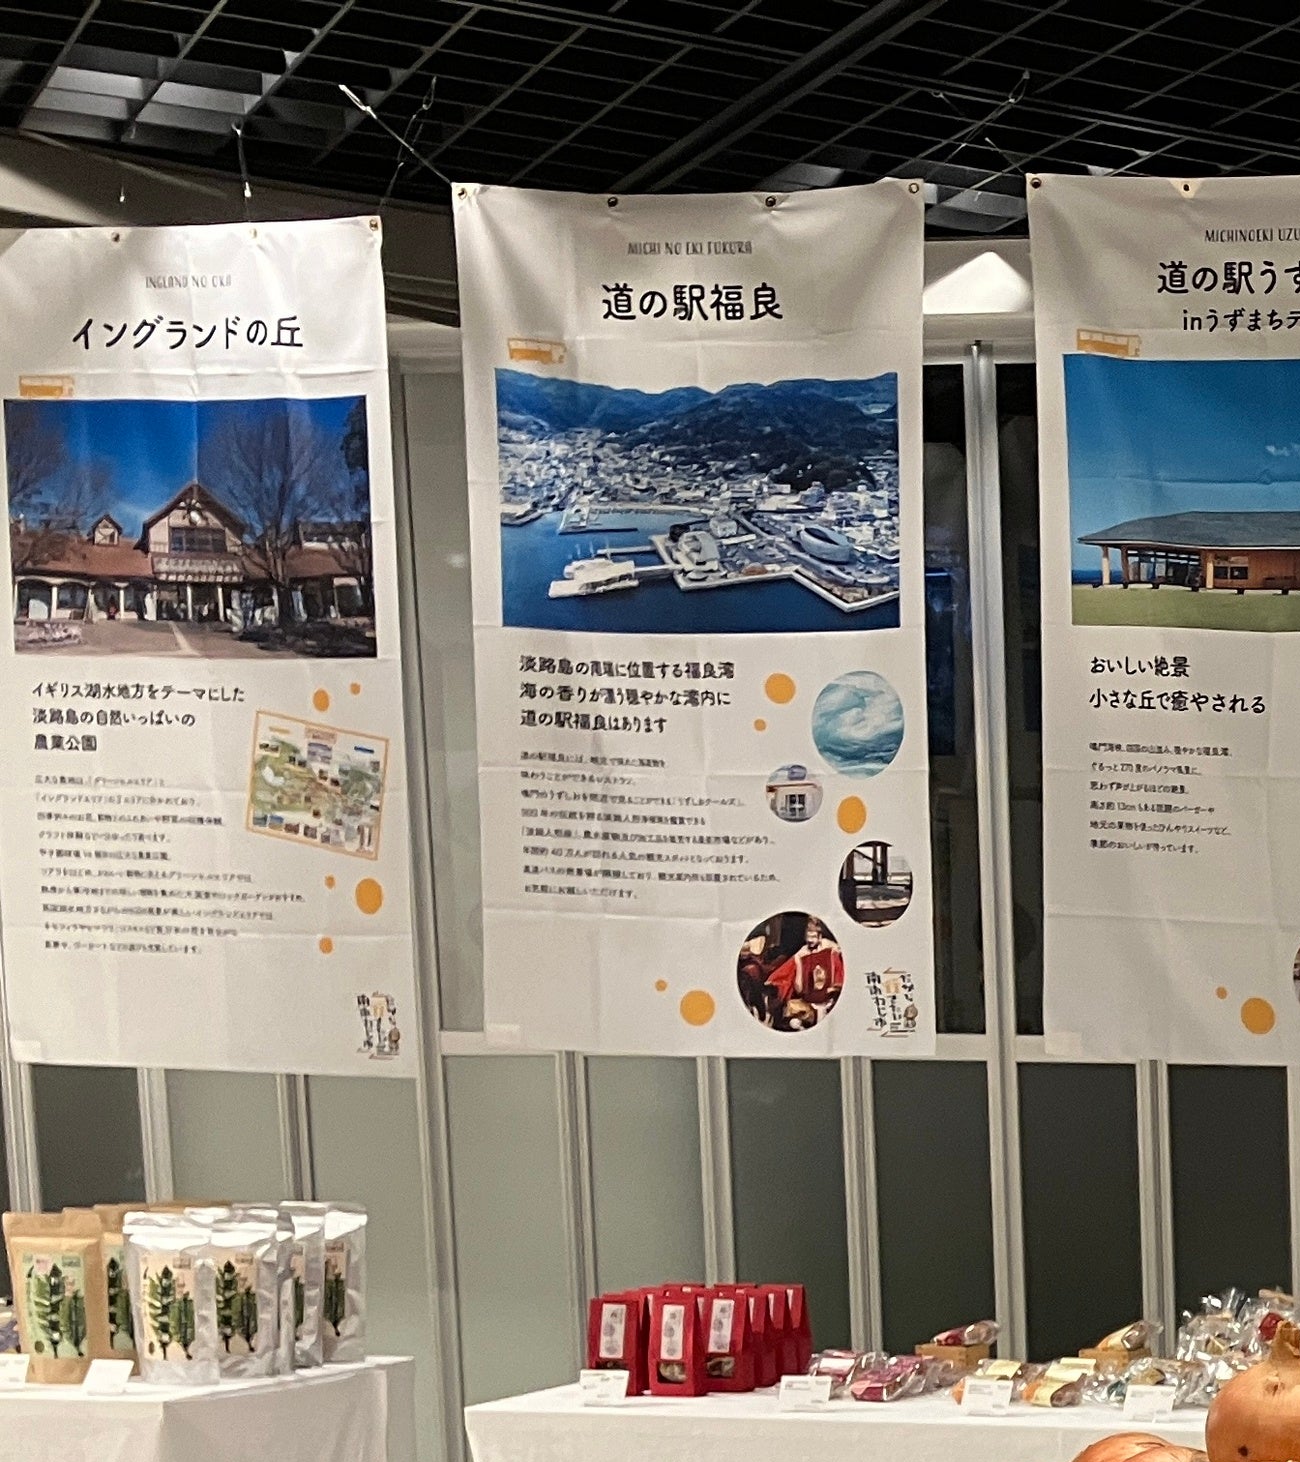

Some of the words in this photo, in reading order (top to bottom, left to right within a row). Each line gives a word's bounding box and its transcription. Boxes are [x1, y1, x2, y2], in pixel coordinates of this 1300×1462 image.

[1205, 229, 1273, 243] MICHINOEKI
[627, 241, 660, 255] MICHI
[665, 241, 681, 254] NO
[191, 275, 207, 288] NO
[601, 282, 783, 322] 道の駅福良
[72, 315, 303, 350] イングランドの丘
[1089, 656, 1190, 678] おいしい絶景
[1089, 689, 1266, 714] 小さな丘で癒やされる
[33, 708, 195, 726] 淡路島の自然いっぱいの
[520, 709, 667, 733] 道の駅福良はあります
